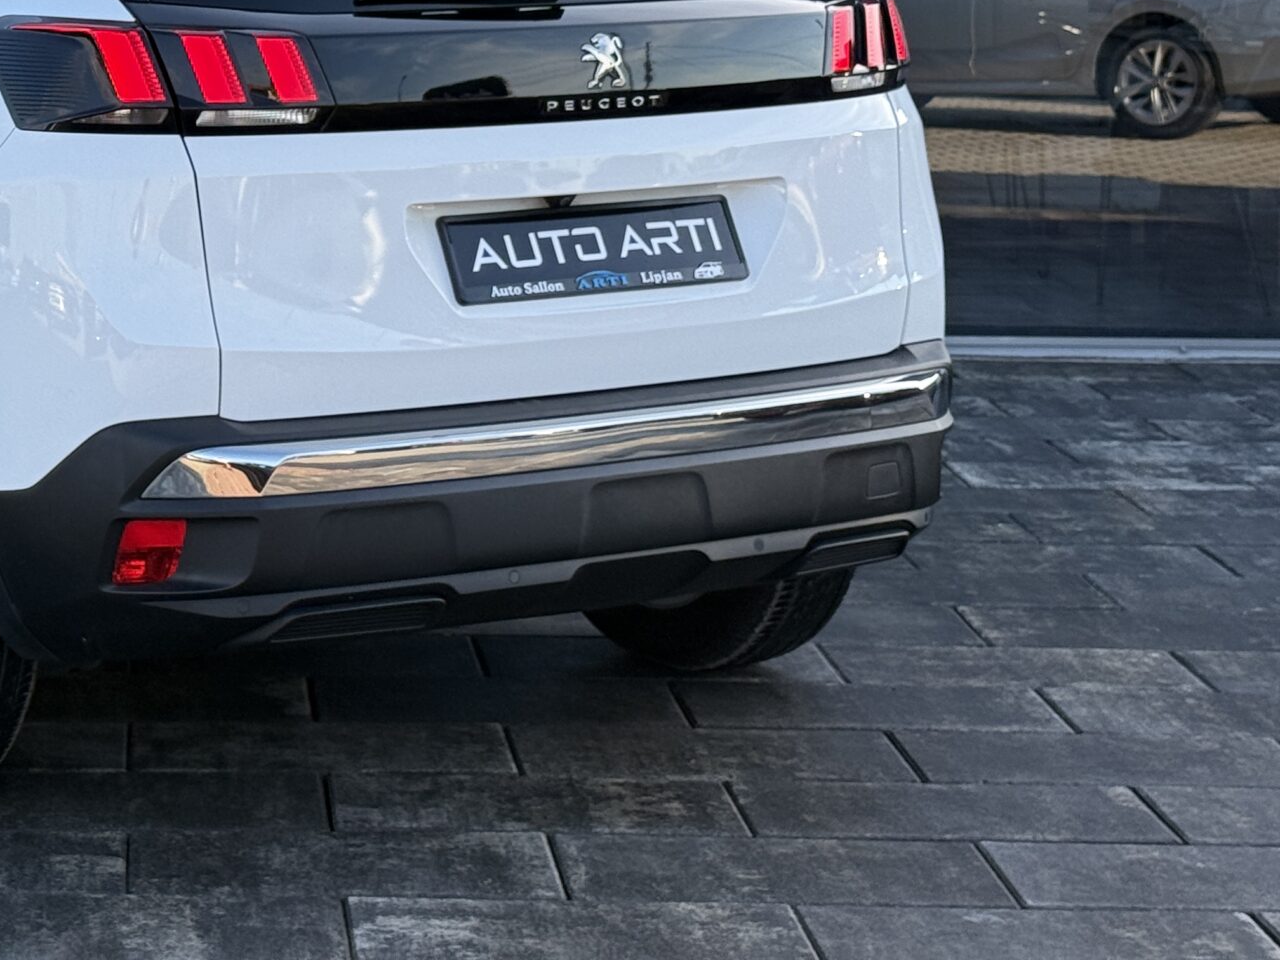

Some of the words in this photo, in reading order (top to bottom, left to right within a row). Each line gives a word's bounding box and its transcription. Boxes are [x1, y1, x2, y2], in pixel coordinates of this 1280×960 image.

[546, 94, 661, 113] PEUGEOT
[472, 225, 608, 273] AUTO
[620, 217, 723, 259] ARTI
[490, 285, 522, 298] Auto
[524, 281, 565, 295] Sallon
[577, 274, 630, 290] ARTI
[639, 270, 684, 285] Lipjan
